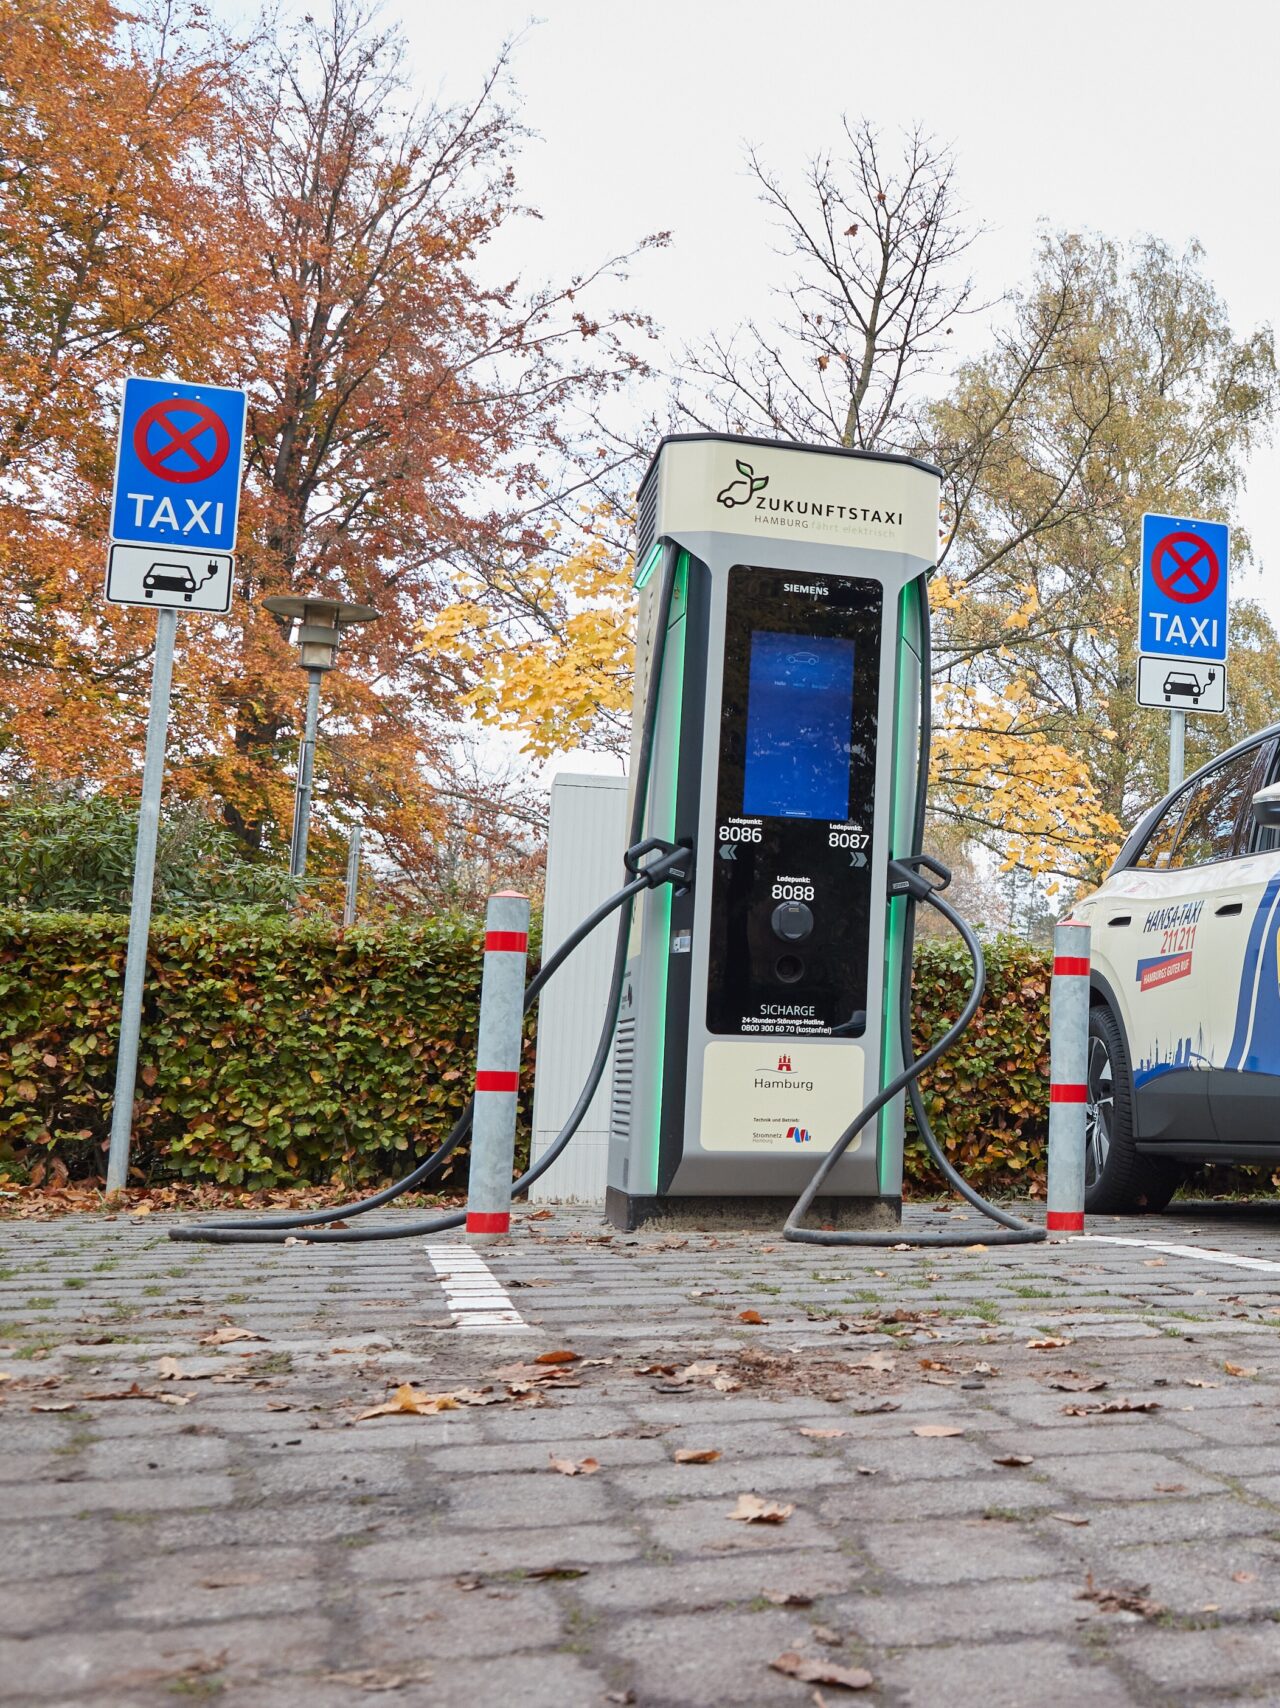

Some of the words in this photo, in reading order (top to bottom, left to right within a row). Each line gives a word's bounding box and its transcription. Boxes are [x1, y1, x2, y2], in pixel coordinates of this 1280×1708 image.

[127, 493, 224, 535] TAXI
[755, 496, 903, 526] ZUKUNFTSTAXI
[754, 515, 809, 529] HAMBURG
[811, 522, 839, 532] fährt
[843, 525, 896, 539] elektrisch
[783, 583, 829, 596] SIEMENS
[1149, 612, 1218, 648] TAXI
[719, 826, 763, 843] 8086
[828, 832, 870, 849] 8087
[771, 884, 815, 901] 8088
[1143, 900, 1205, 933] HANSA-TAXI
[760, 1004, 816, 1017] SICHARGE
[741, 1024, 760, 1032] 0800
[775, 1025, 785, 1033] 60
[785, 1025, 795, 1033] 70
[754, 1078, 814, 1092] Hamburg
[752, 1131, 783, 1139] Stromnetz
